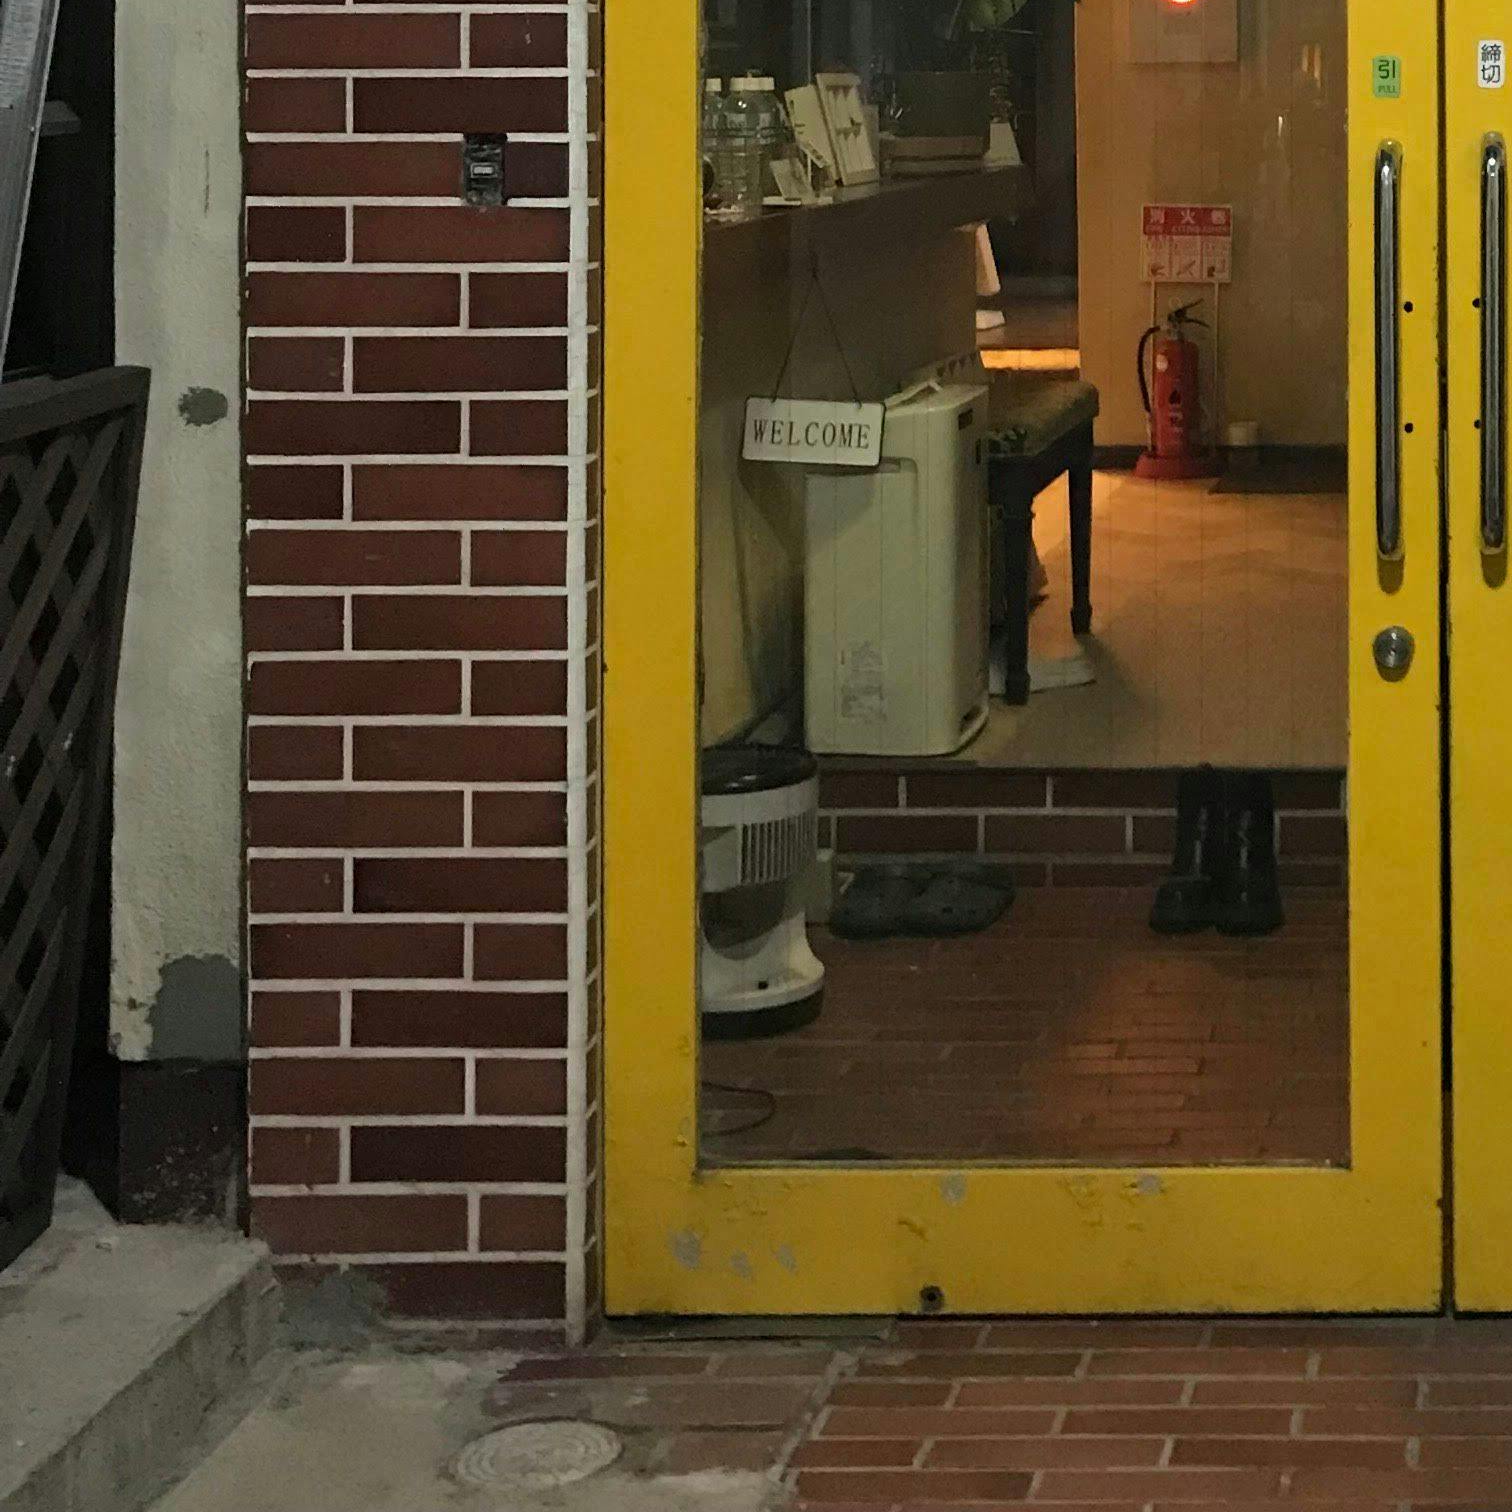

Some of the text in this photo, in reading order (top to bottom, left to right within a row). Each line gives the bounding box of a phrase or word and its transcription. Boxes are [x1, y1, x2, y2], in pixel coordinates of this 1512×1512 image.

[1378, 59, 1396, 79] 引
[1481, 44, 1501, 84] 締切
[754, 419, 871, 449] WELCOME
